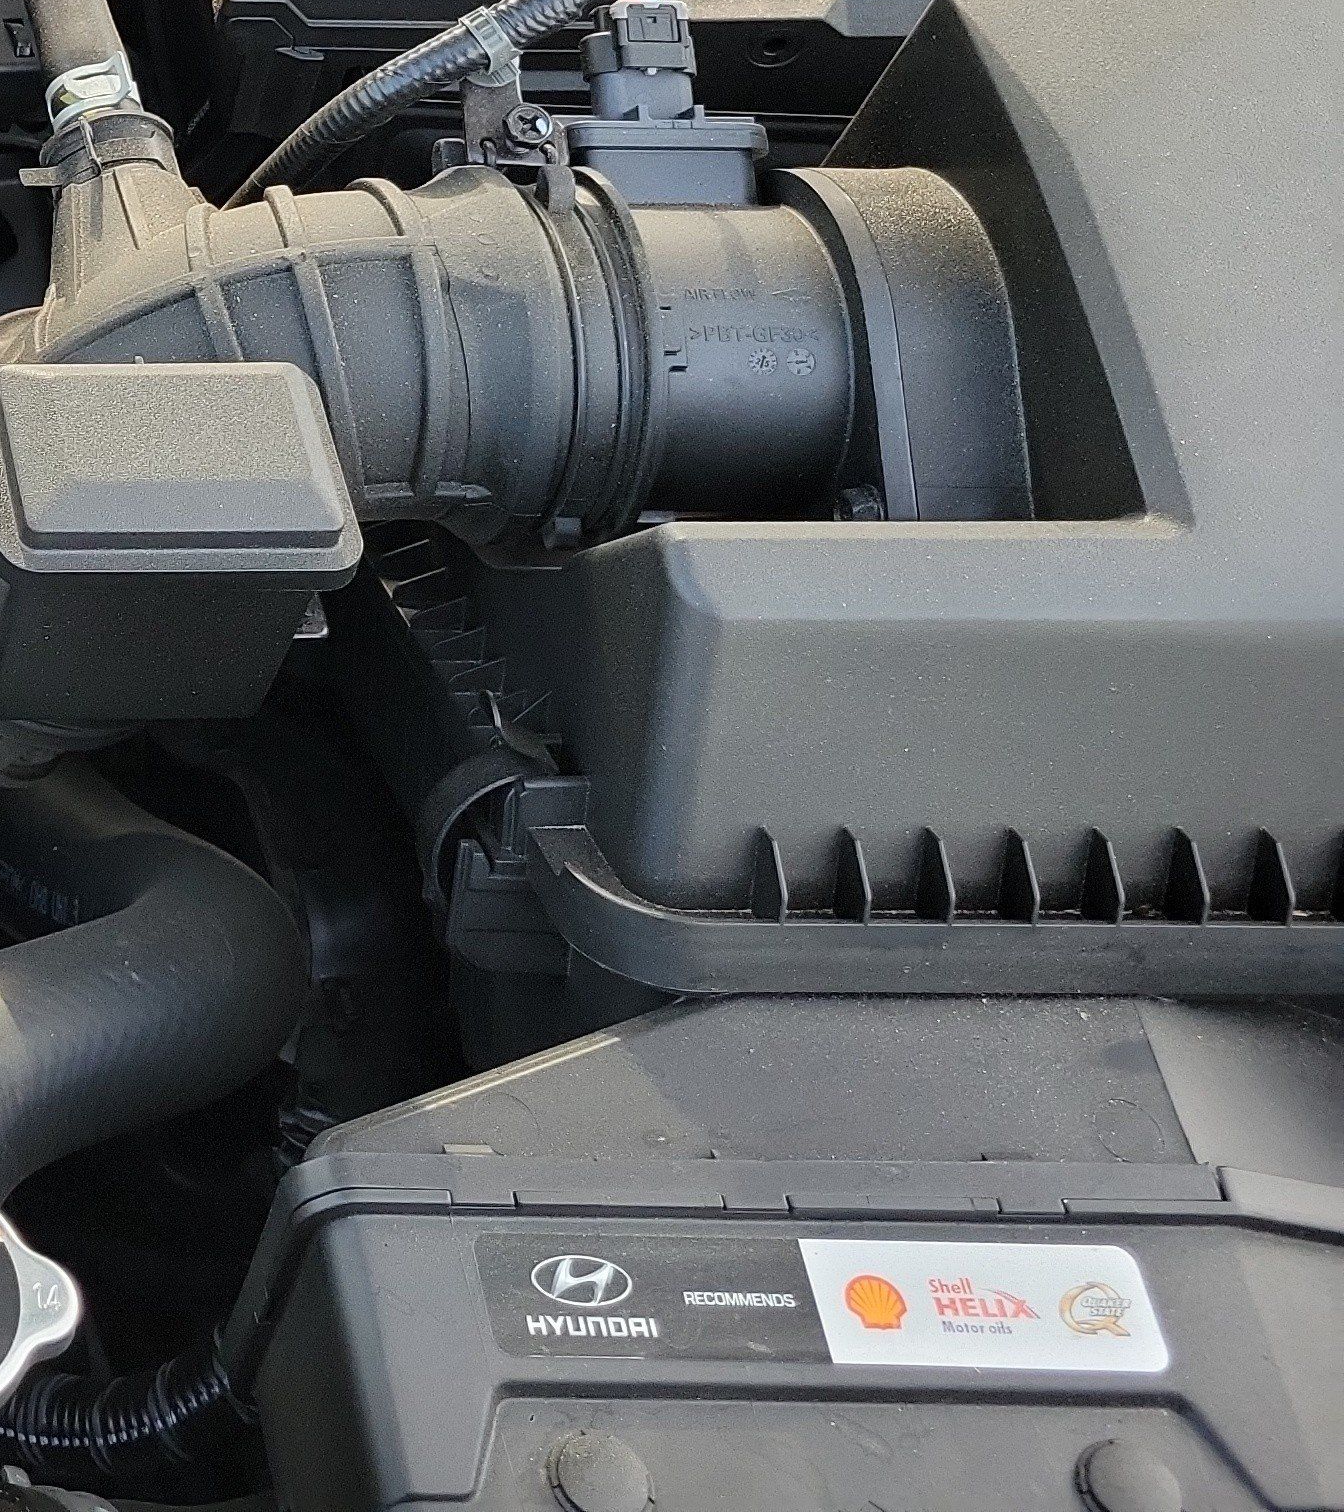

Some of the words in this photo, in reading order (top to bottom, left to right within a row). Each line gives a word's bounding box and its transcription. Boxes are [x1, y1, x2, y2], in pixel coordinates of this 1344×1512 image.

[928, 1277, 974, 1295] Shell
[682, 1290, 797, 1308] RECOMMENDS
[932, 1296, 1036, 1319] HELIX
[525, 1314, 659, 1338] HYUNDAI
[941, 1320, 985, 1334] Motor
[988, 1320, 1013, 1335] oils
